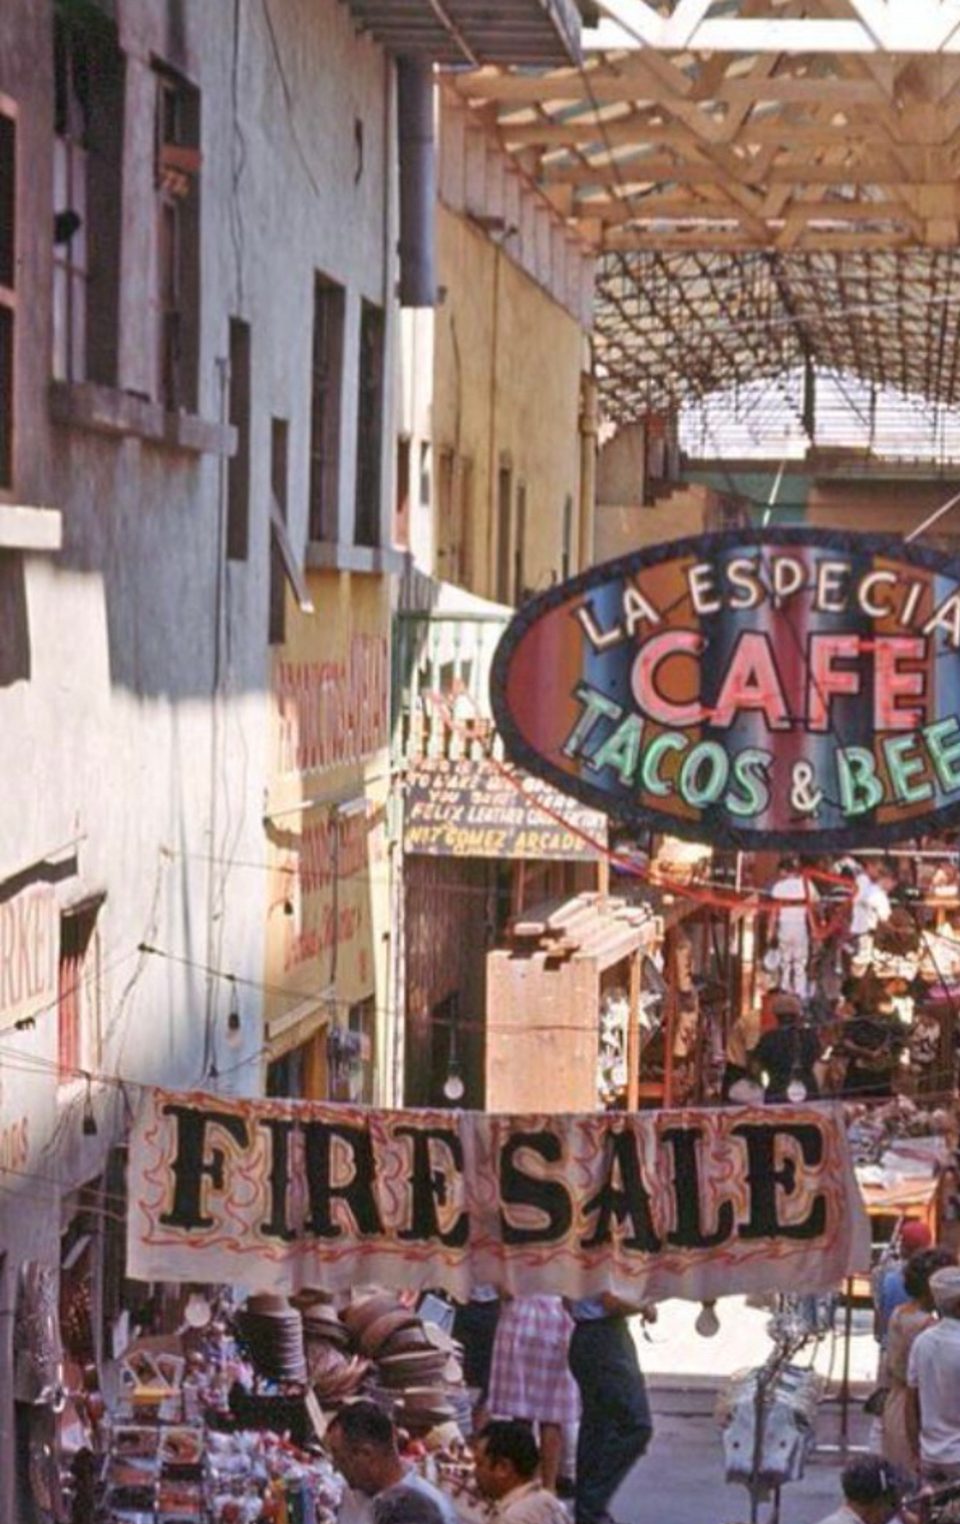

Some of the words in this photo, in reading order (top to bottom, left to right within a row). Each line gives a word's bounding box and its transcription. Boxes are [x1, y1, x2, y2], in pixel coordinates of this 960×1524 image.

[577, 584, 660, 648] LA
[630, 630, 931, 733] CAFE
[560, 686, 774, 816] TACOS
[791, 762, 822, 813] &
[159, 1104, 470, 1248] FIRE
[500, 1121, 829, 1253] SALE
